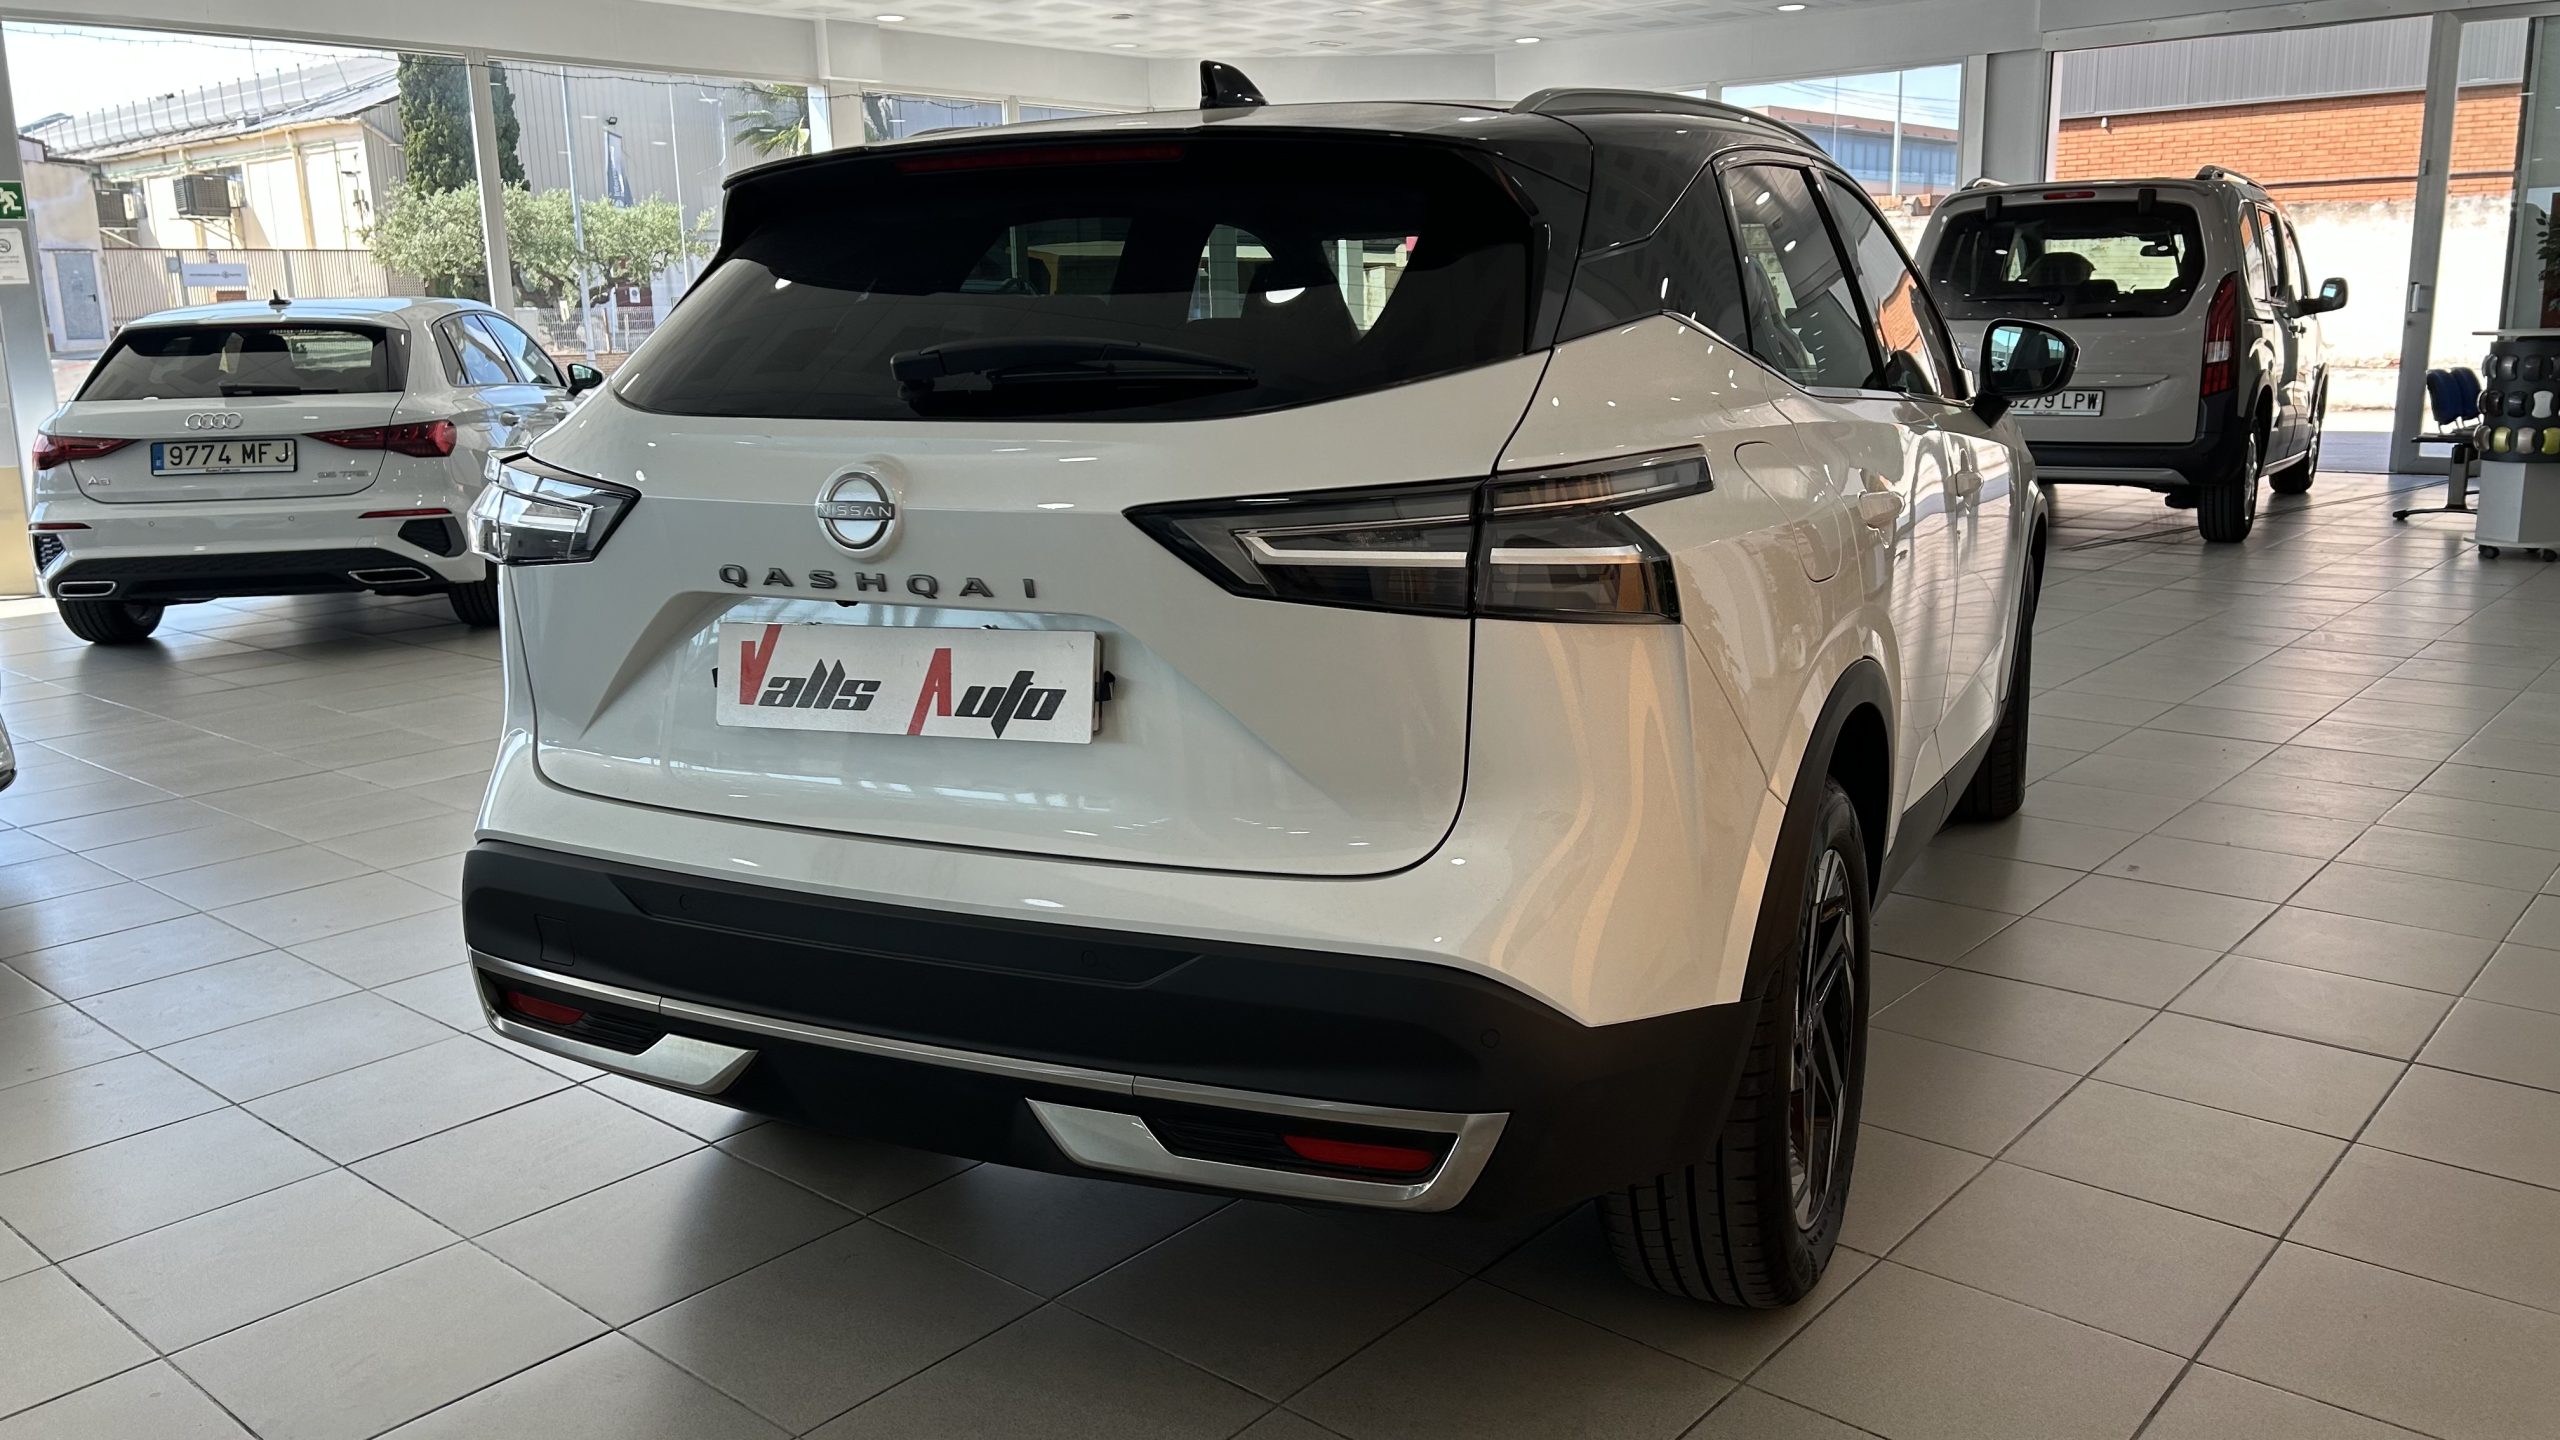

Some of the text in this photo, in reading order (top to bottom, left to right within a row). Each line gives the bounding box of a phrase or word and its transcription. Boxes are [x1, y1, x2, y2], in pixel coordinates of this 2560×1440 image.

[2062, 393, 2098, 409] LPW
[170, 443, 289, 466] 9774 MFJ
[819, 503, 892, 517] NISSAN
[719, 564, 1037, 599] QASHQAI
[739, 624, 1067, 739] Valls Auto
